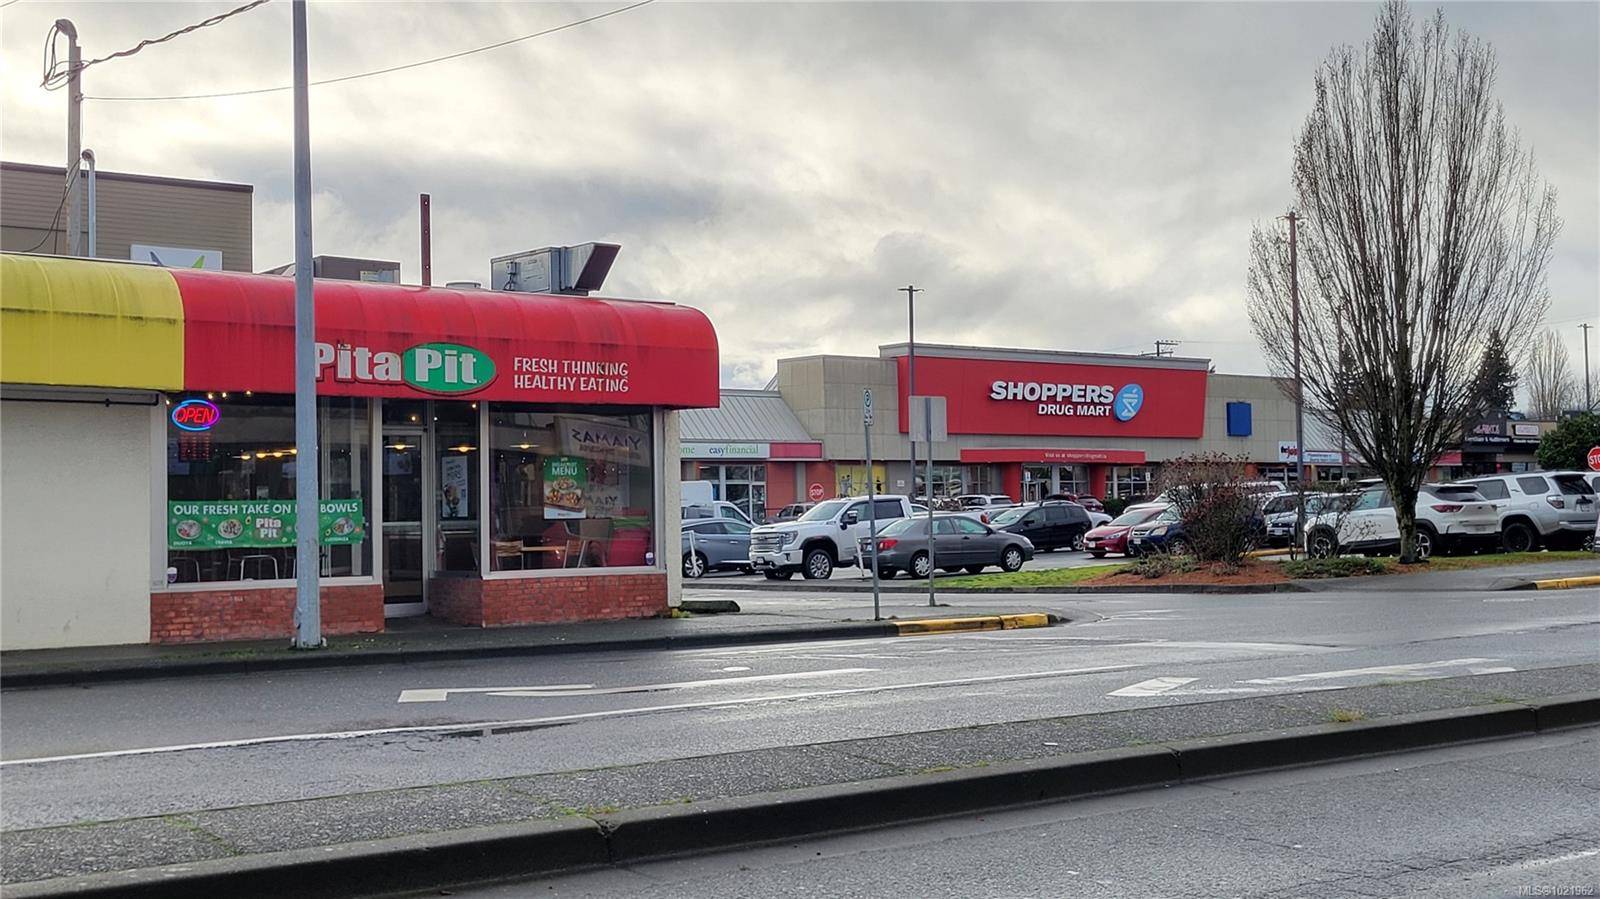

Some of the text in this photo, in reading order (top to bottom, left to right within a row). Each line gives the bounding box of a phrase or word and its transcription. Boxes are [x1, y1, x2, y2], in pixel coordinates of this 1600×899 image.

[315, 342, 478, 384] Pita Pit
[514, 357, 629, 376] FRESH THINKING
[514, 374, 629, 393] HEALTHY EATING
[990, 380, 1114, 404] SHOPPERS
[175, 406, 215, 423] OPEN
[1038, 403, 1112, 417] DRUG MART
[708, 443, 759, 456] easyfinancial
[551, 465, 578, 476] MENU
[173, 504, 200, 516] OUR
[203, 504, 239, 515] FRESH
[241, 503, 270, 514] TAKE
[272, 503, 292, 514] ON
[320, 502, 358, 513] BOWLS
[255, 517, 282, 528] Pita
[260, 527, 279, 539] Pit
